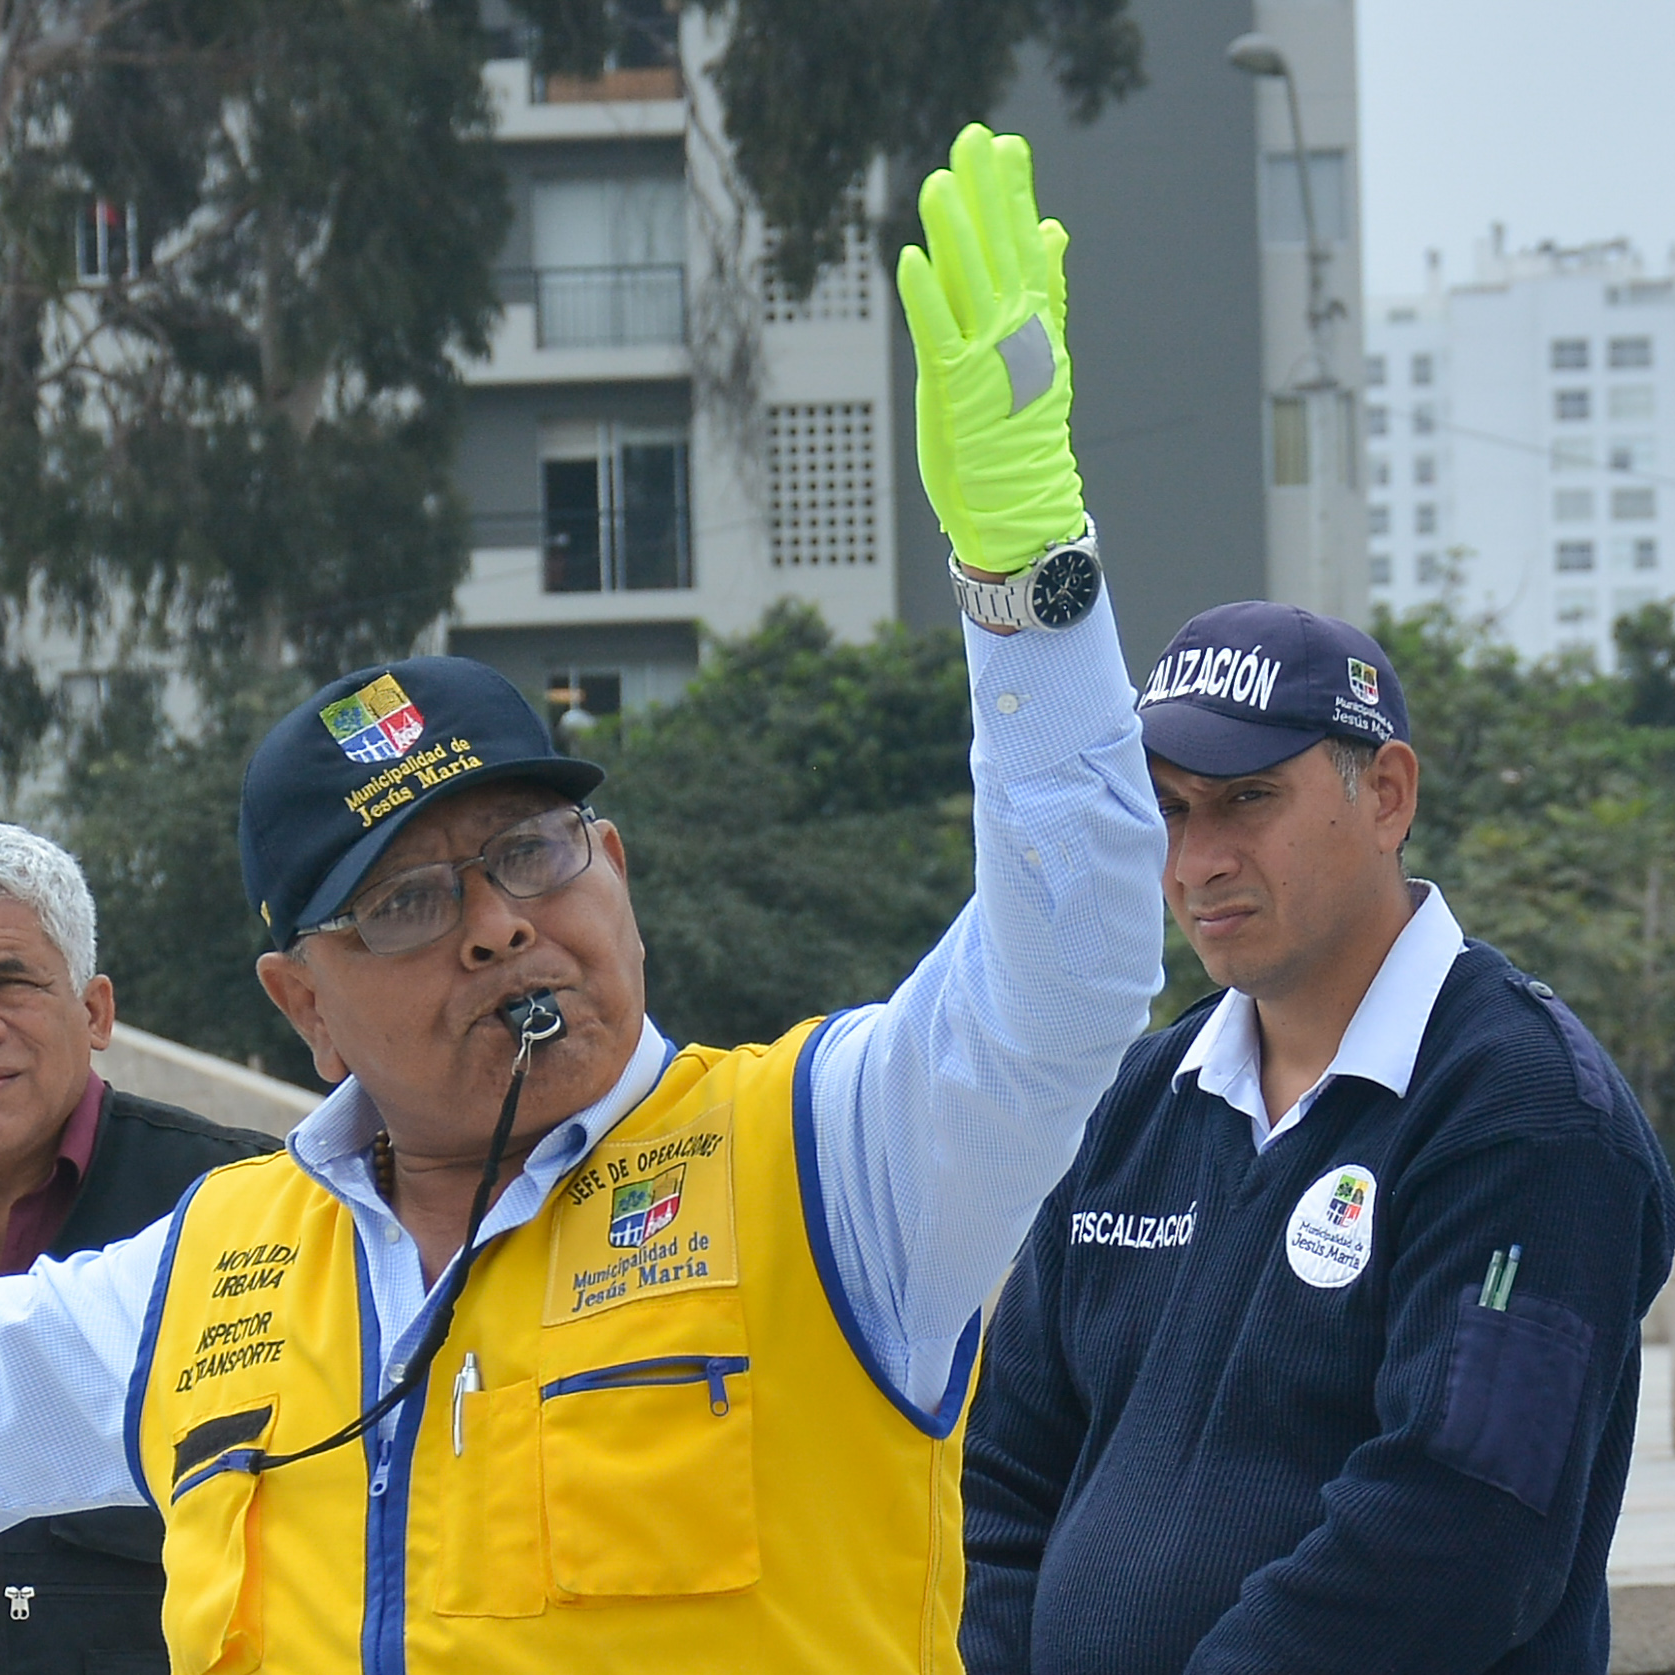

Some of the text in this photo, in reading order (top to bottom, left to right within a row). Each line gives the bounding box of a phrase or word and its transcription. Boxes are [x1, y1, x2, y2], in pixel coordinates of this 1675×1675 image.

[344, 737, 471, 812] Municipalidad de
[356, 754, 483, 827] Jesús María
[568, 1169, 606, 1206] JEFE
[607, 1158, 629, 1183] DE
[213, 1237, 301, 1273] MOVILIDA
[572, 1231, 709, 1291] Municipalidad de
[1292, 1232, 1325, 1256] Jesús
[212, 1268, 285, 1299] URBANA
[571, 1257, 708, 1312] Jesús María
